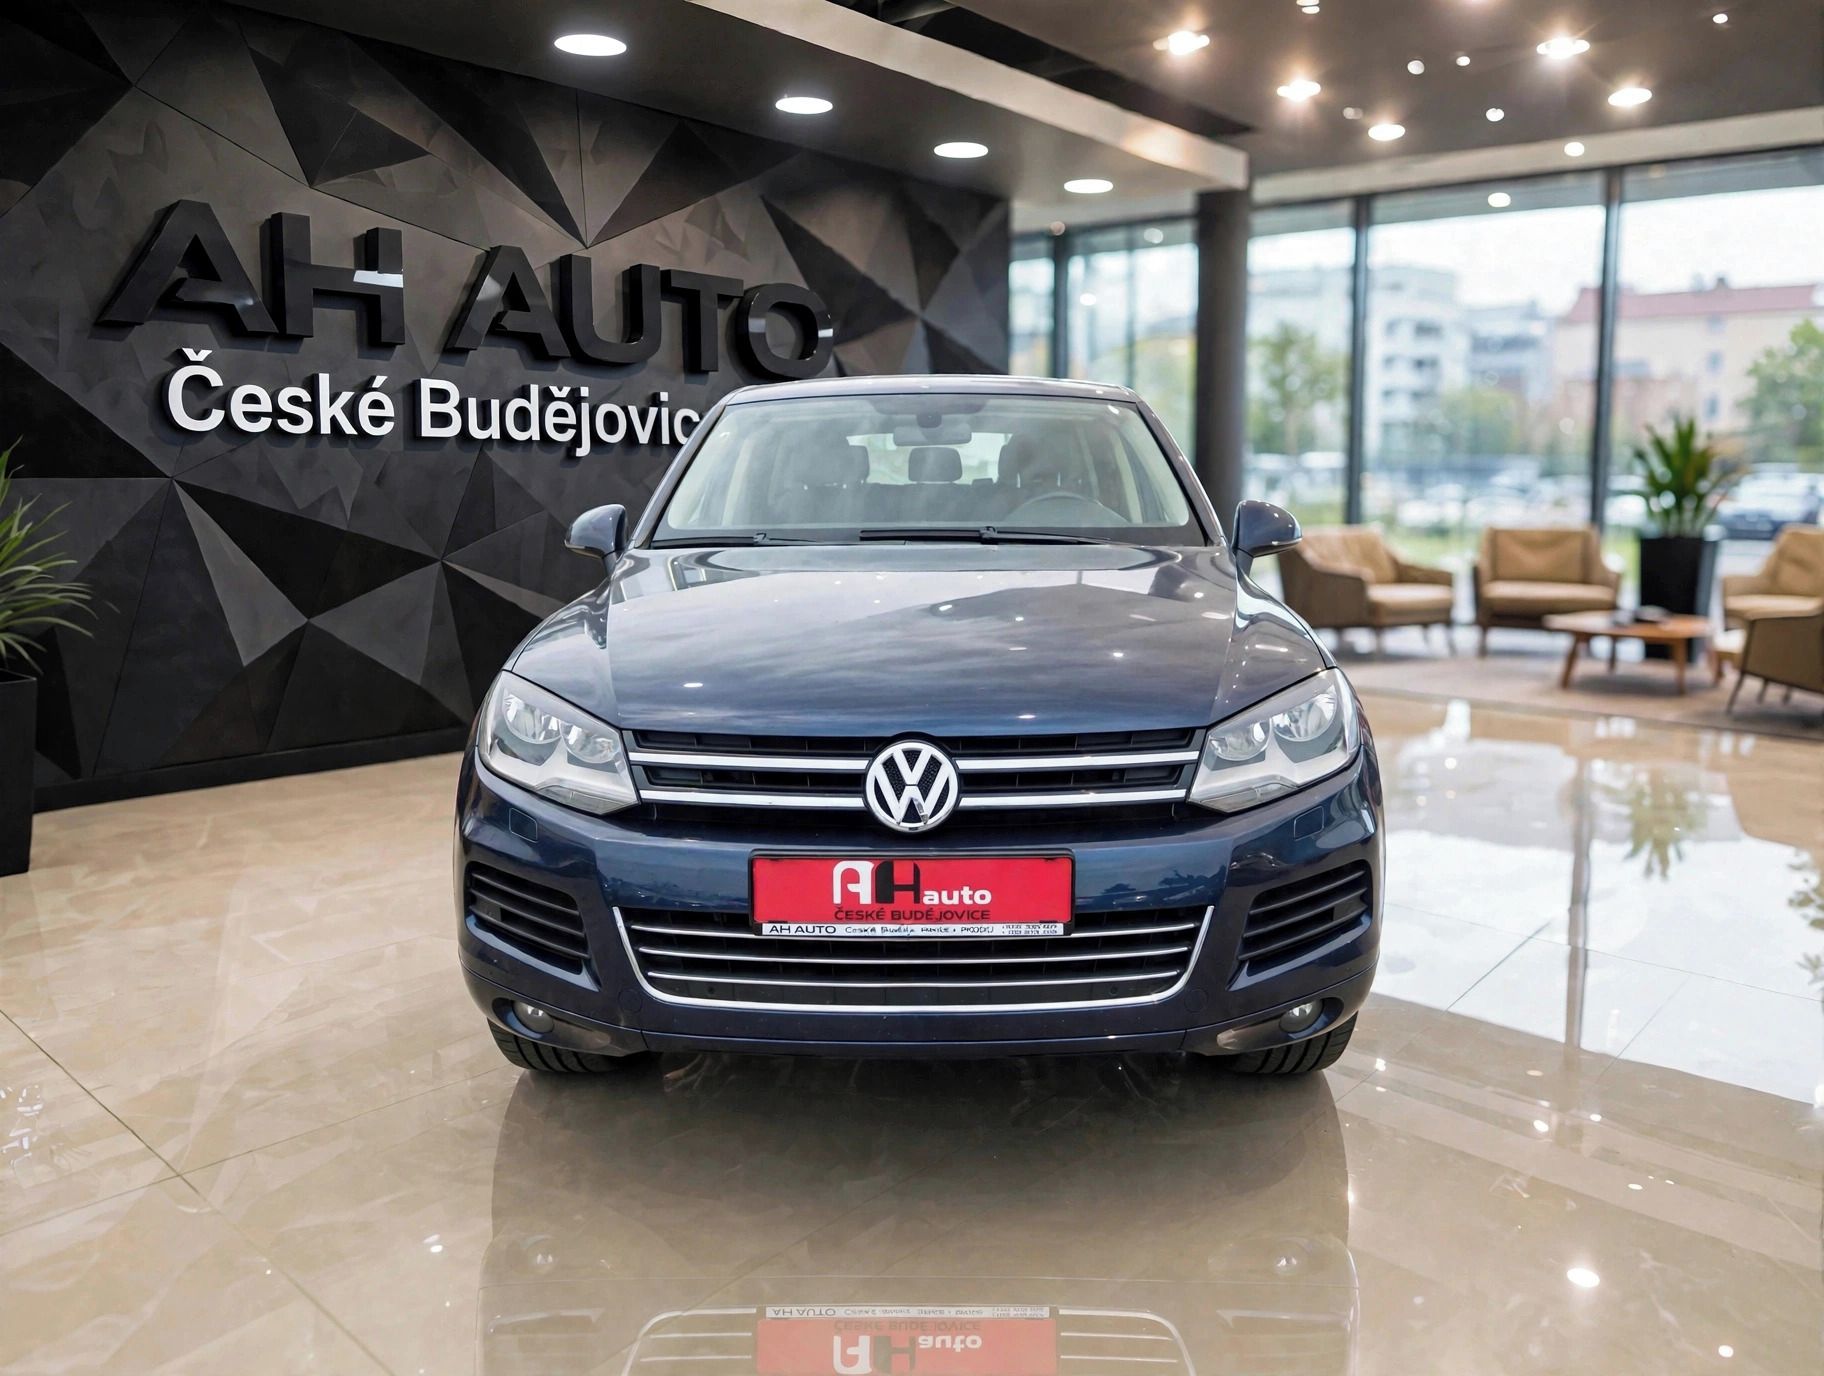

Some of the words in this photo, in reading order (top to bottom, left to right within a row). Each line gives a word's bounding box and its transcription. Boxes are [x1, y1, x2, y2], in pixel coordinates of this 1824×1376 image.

[95, 199, 405, 346] AH
[446, 245, 833, 380] AUTO
[168, 347, 395, 436] České
[419, 377, 700, 457] Budějovic
[769, 925, 791, 934] AH
[794, 925, 837, 934] AUTO
[834, 906, 885, 921] ČESKÉ
